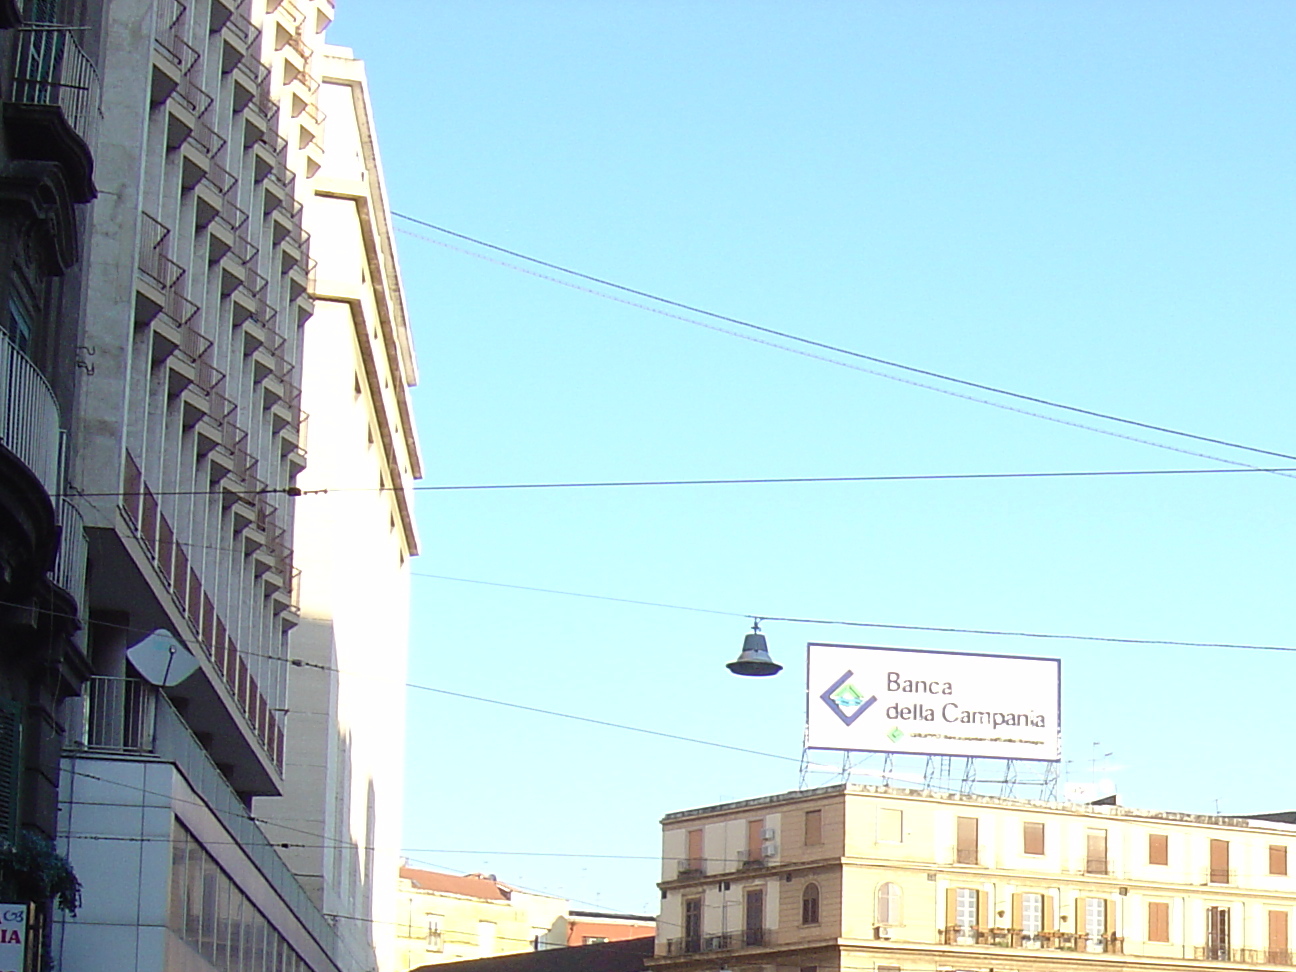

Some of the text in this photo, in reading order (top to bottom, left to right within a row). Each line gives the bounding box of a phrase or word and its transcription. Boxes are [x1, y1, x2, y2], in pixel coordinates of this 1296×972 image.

[886, 671, 953, 696] Banca
[885, 702, 1046, 730] della Campania
